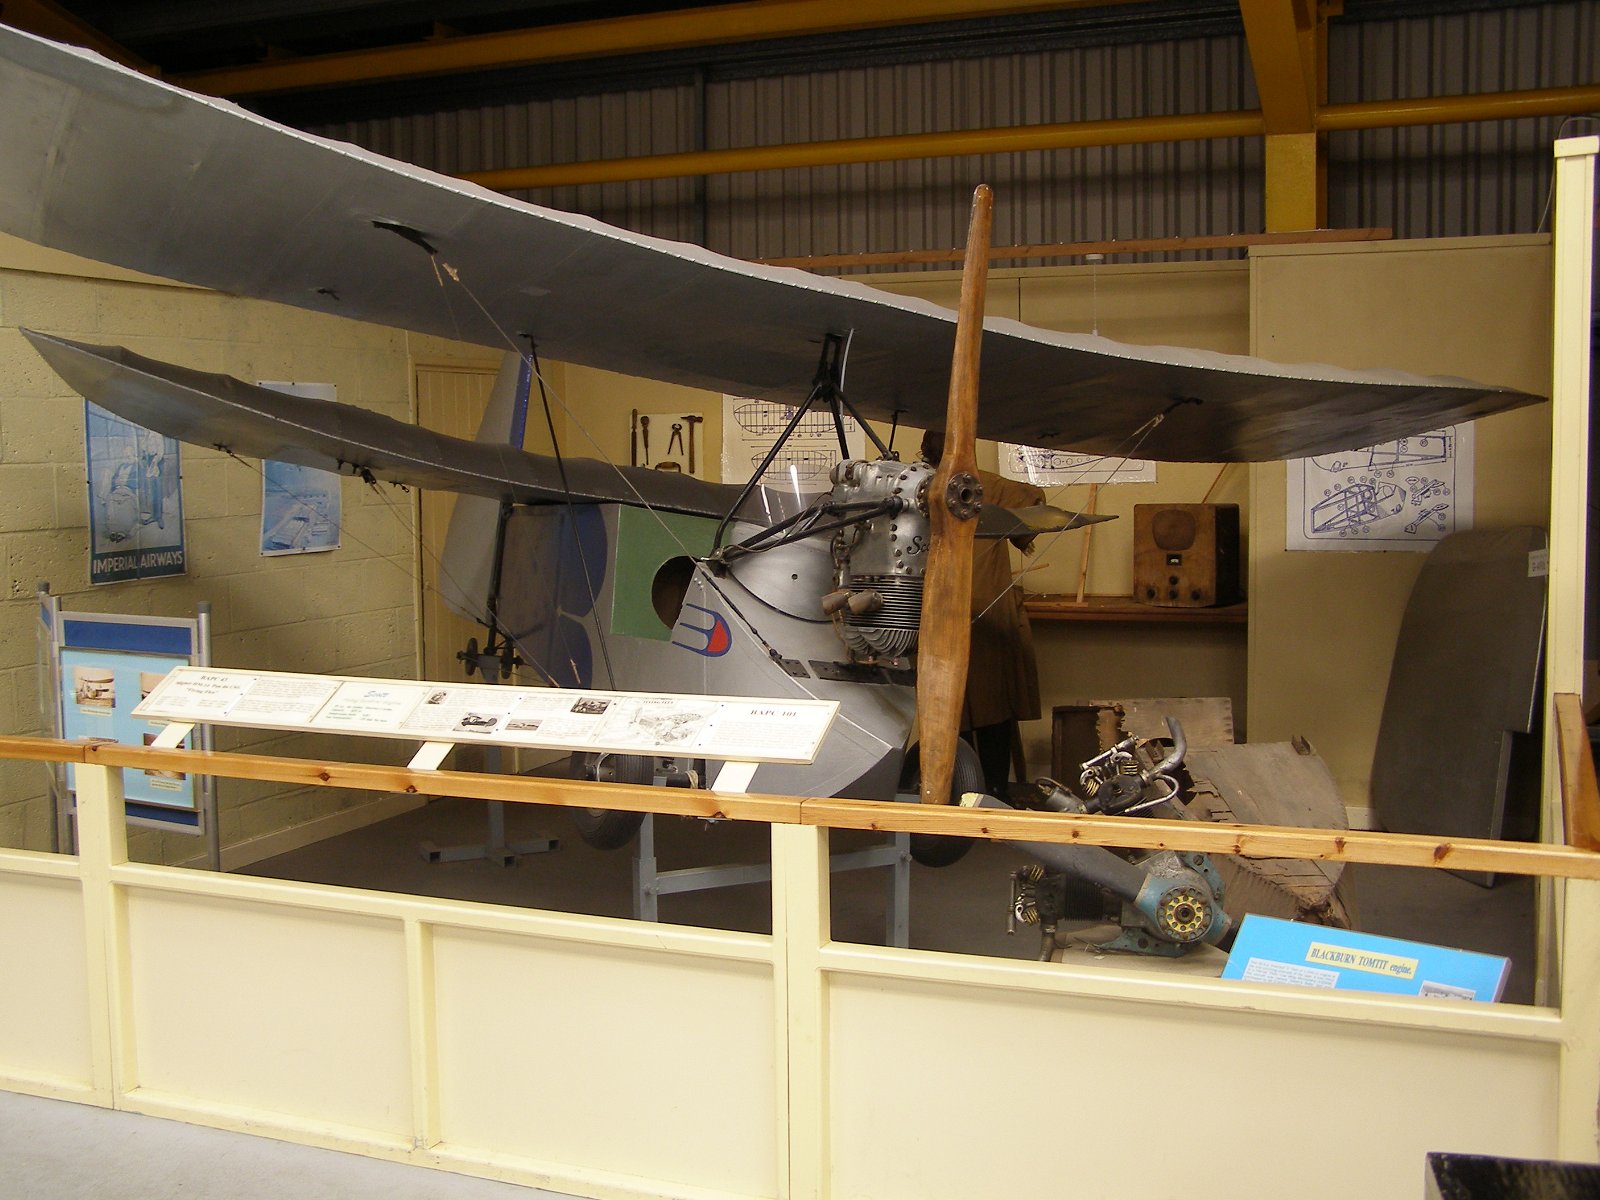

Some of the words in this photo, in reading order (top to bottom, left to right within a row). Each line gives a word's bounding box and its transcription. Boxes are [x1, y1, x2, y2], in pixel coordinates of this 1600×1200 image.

[93, 555, 138, 574] IMPERIAL
[140, 551, 183, 569] AIRWAYS
[1310, 948, 1356, 964] BLACKBURN
[1358, 955, 1389, 970] TOMTIT
[1389, 962, 1412, 975] engine.
